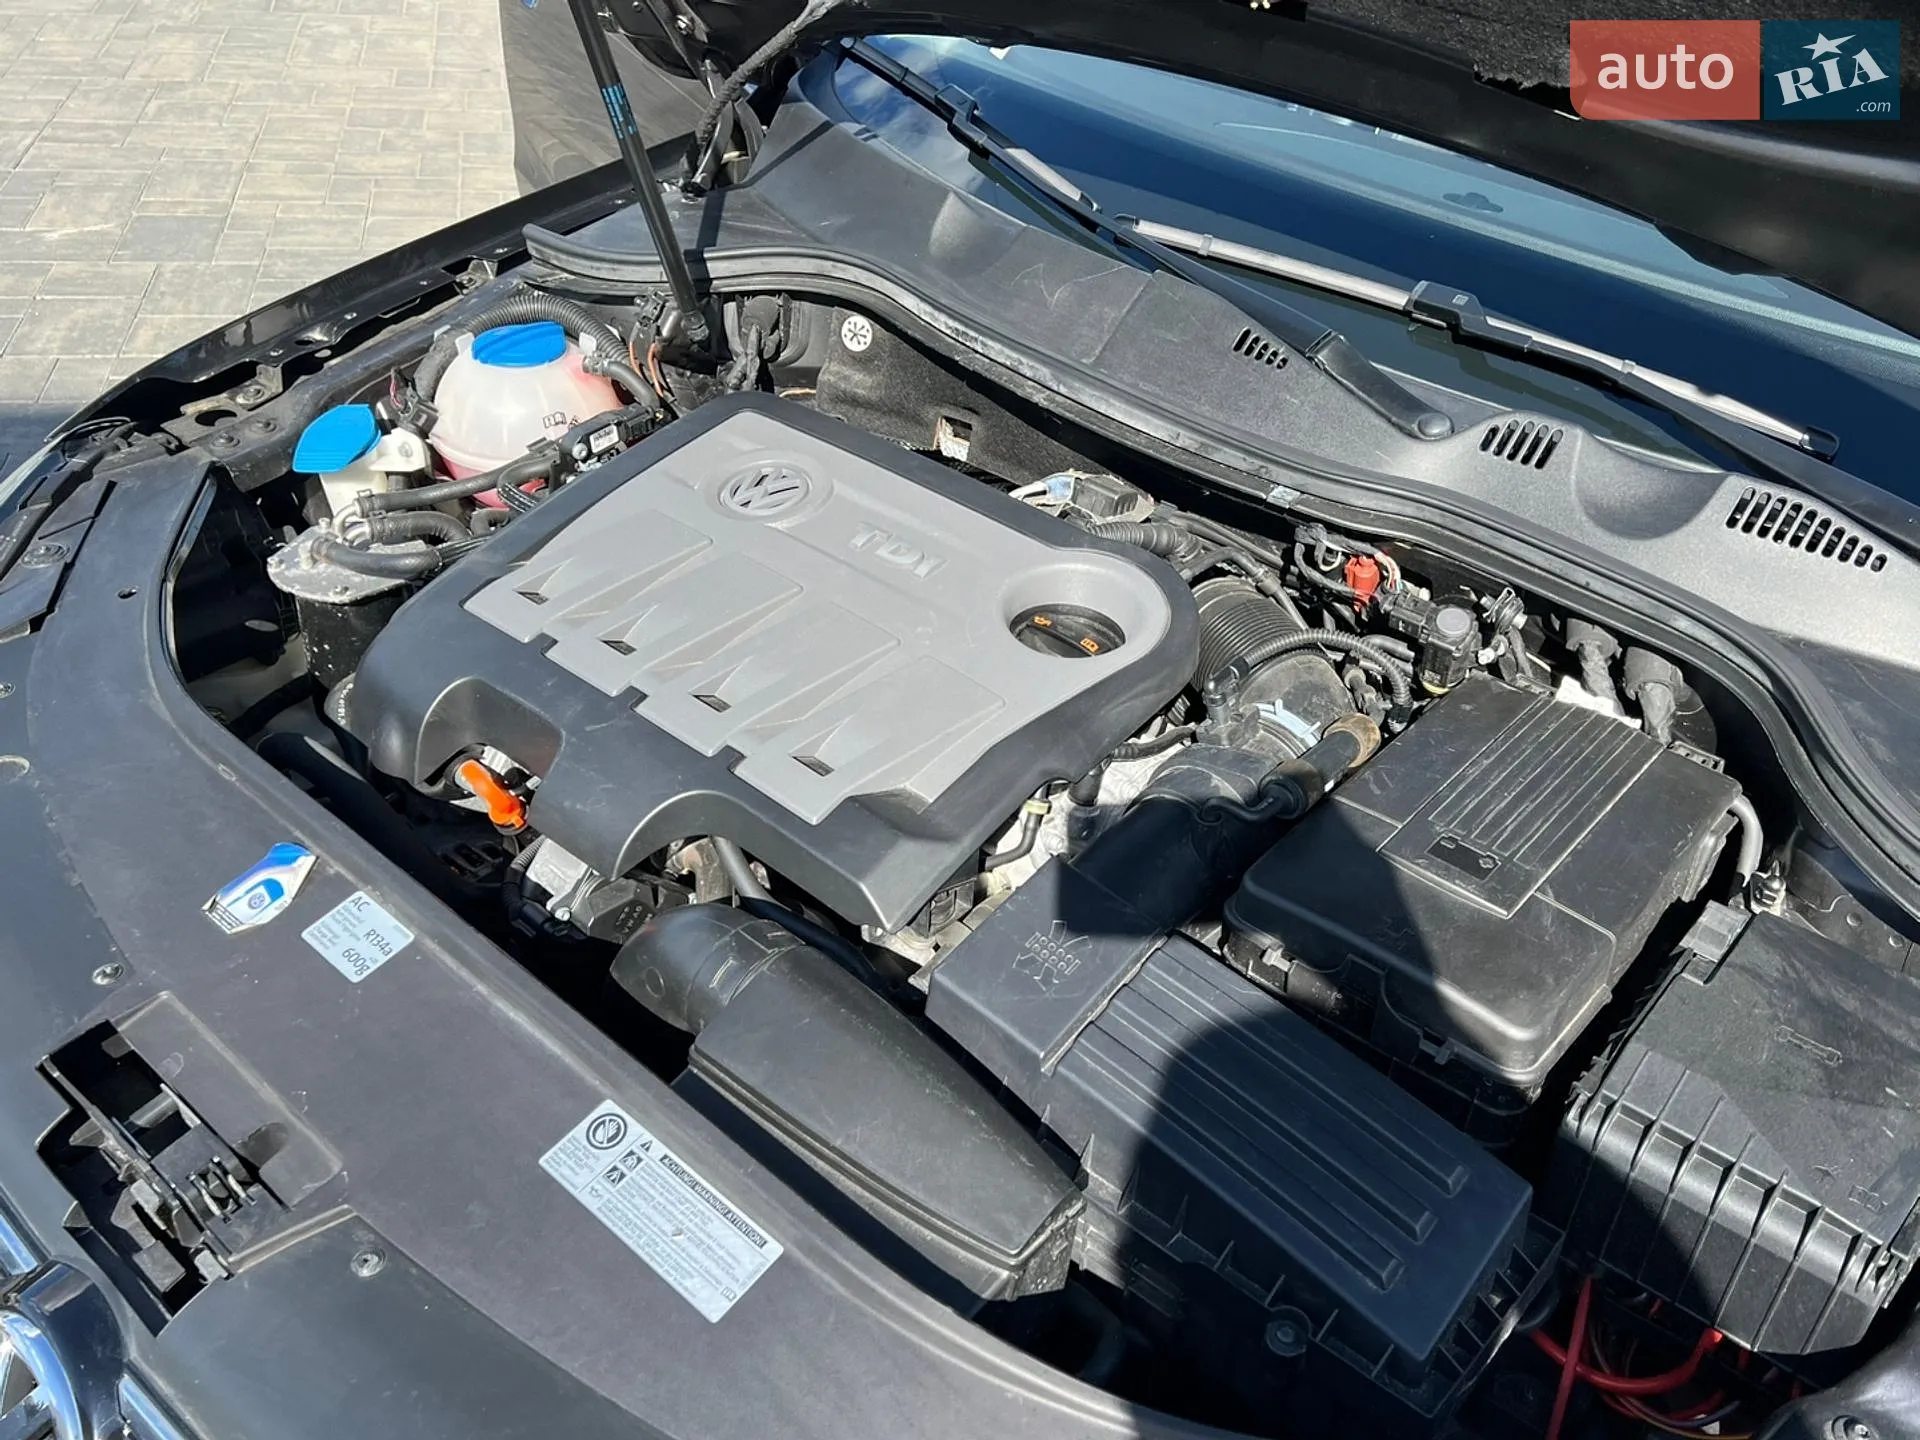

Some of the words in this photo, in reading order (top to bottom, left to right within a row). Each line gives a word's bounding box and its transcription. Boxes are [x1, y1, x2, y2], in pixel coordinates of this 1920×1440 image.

[849, 521, 950, 580] TDI
[350, 895, 371, 913] AC
[364, 928, 395, 957] R134a
[341, 947, 371, 977] 600g
